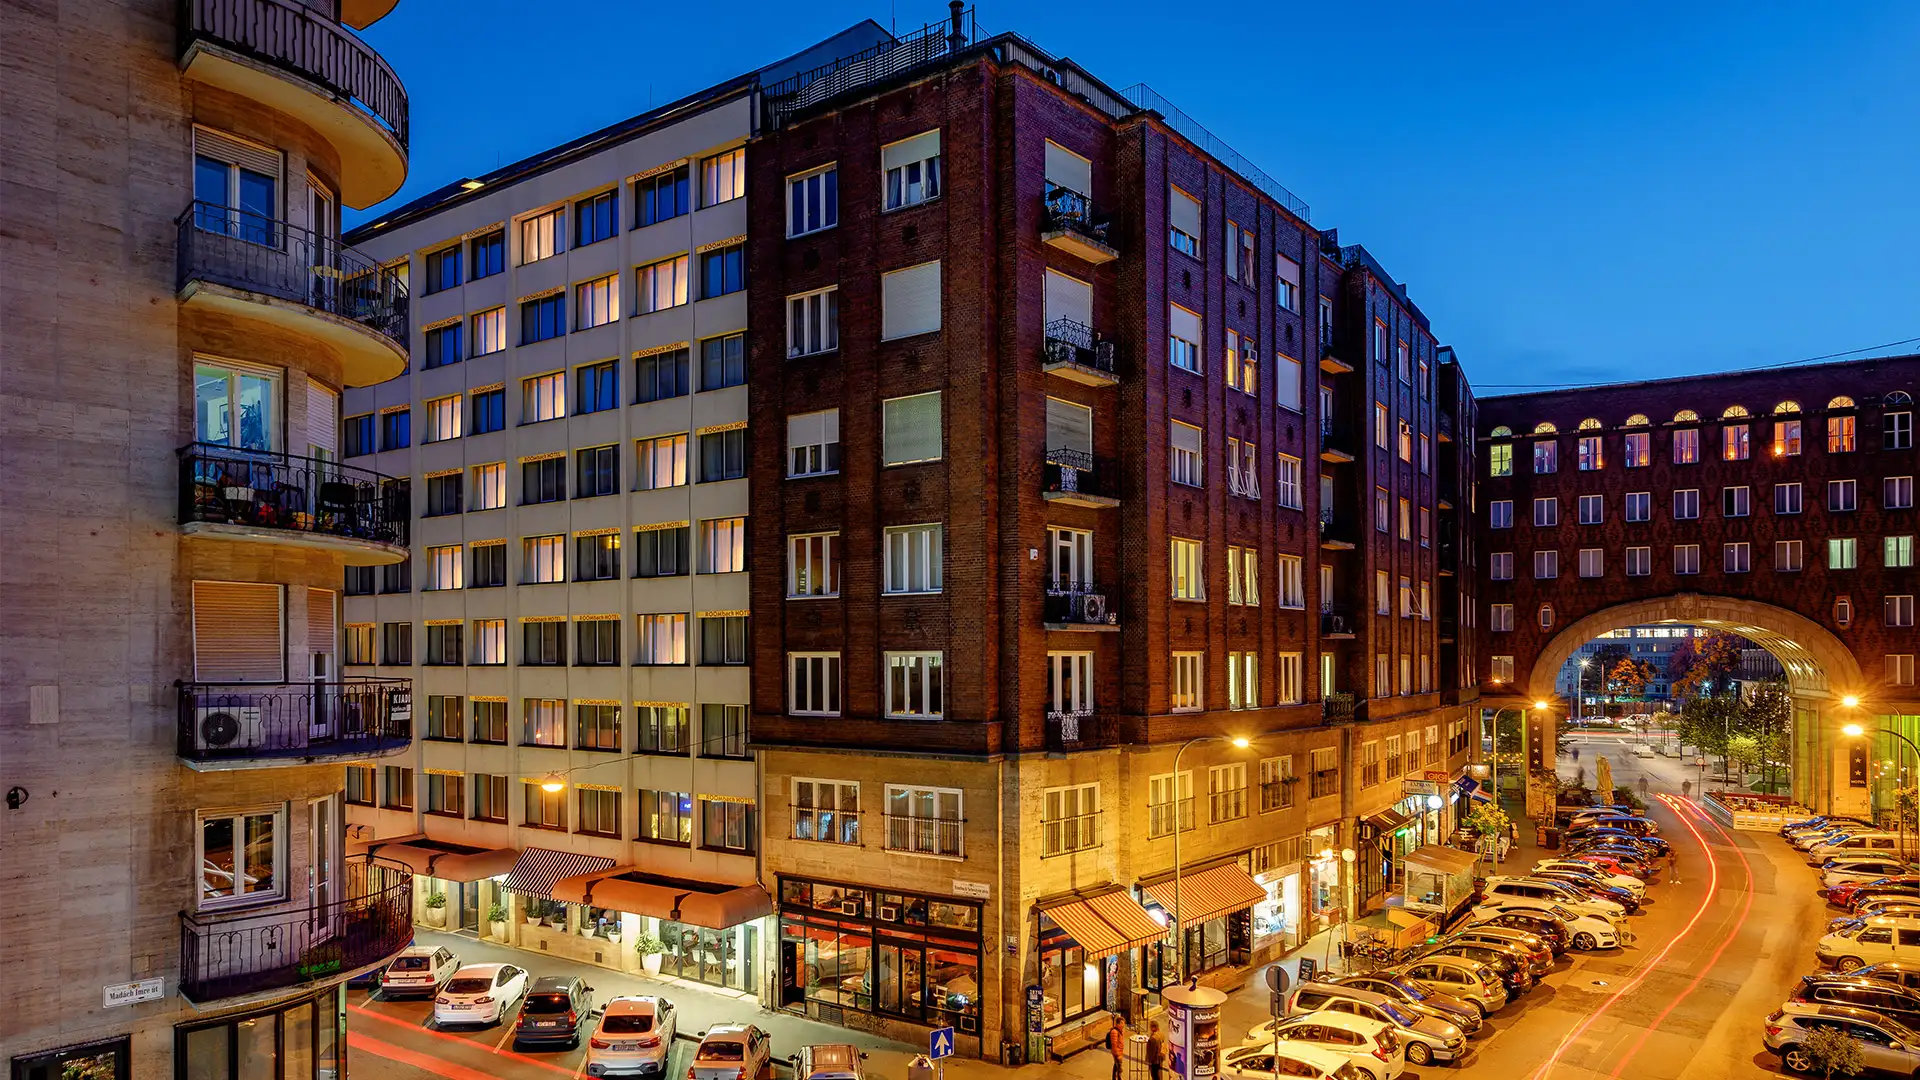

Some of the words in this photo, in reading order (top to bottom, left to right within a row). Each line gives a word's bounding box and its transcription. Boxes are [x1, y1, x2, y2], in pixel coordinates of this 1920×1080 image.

[110, 990, 134, 1000] Madách
[135, 988, 150, 996] Imre
[151, 986, 158, 994] út
